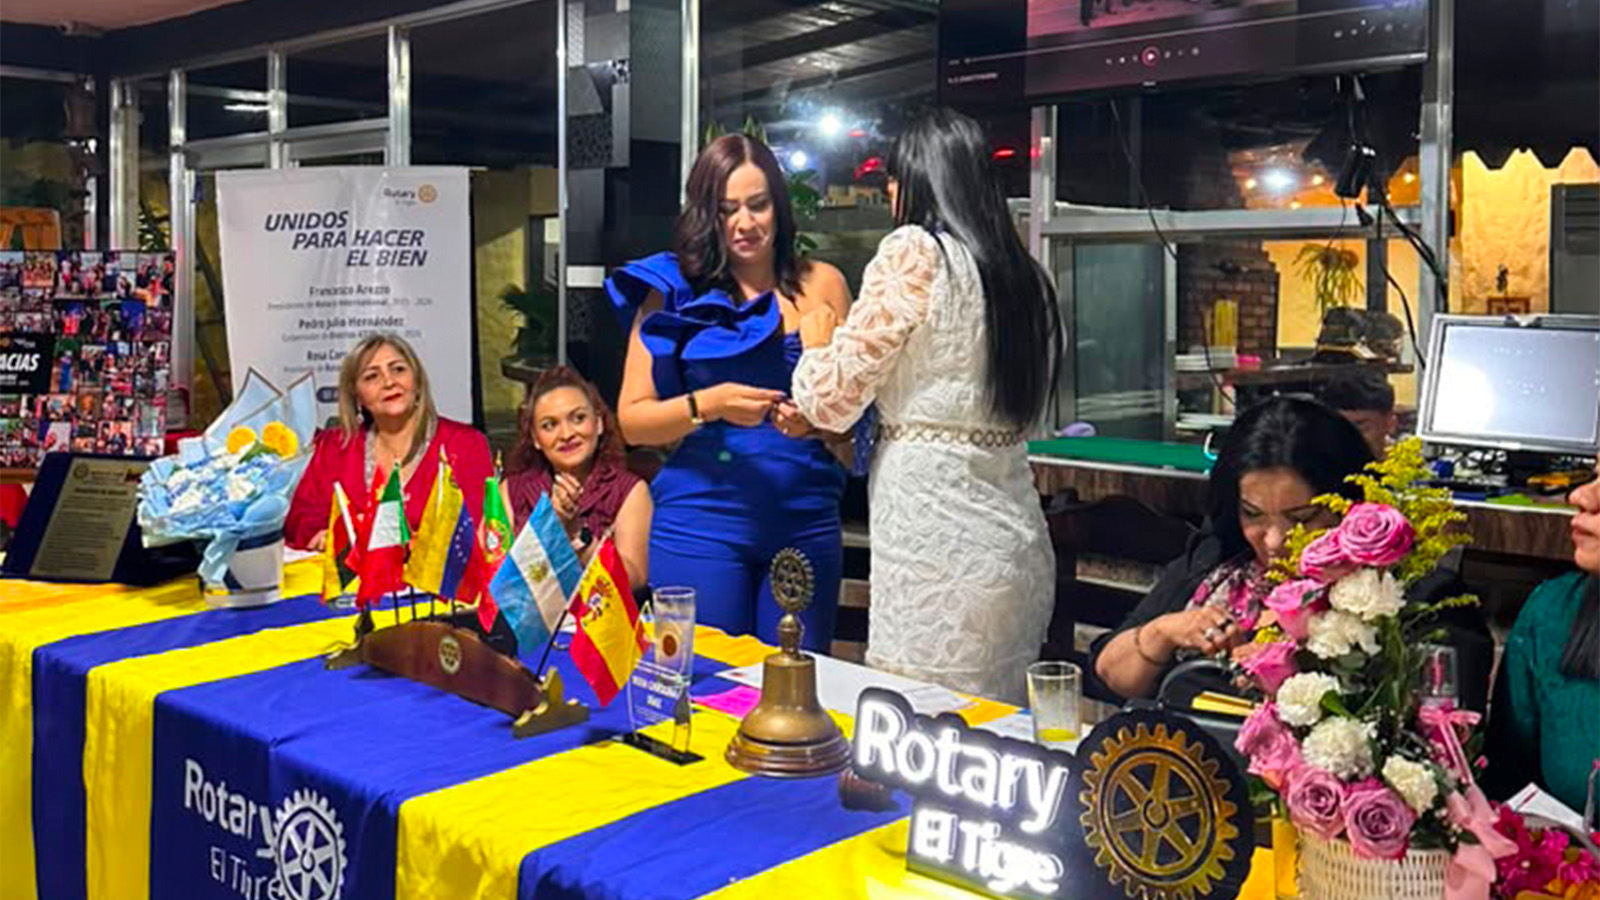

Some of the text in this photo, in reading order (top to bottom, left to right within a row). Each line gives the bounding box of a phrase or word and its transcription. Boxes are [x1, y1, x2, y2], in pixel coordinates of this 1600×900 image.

[264, 210, 349, 232] UNIDOS
[292, 229, 425, 250] PARA HACER
[346, 249, 428, 267] EL BIEN
[299, 318, 325, 330] Pedro
[856, 699, 1069, 834] Rotary
[184, 758, 276, 859] Rotary
[210, 846, 226, 883] El
[913, 808, 1064, 894] El Tigre
